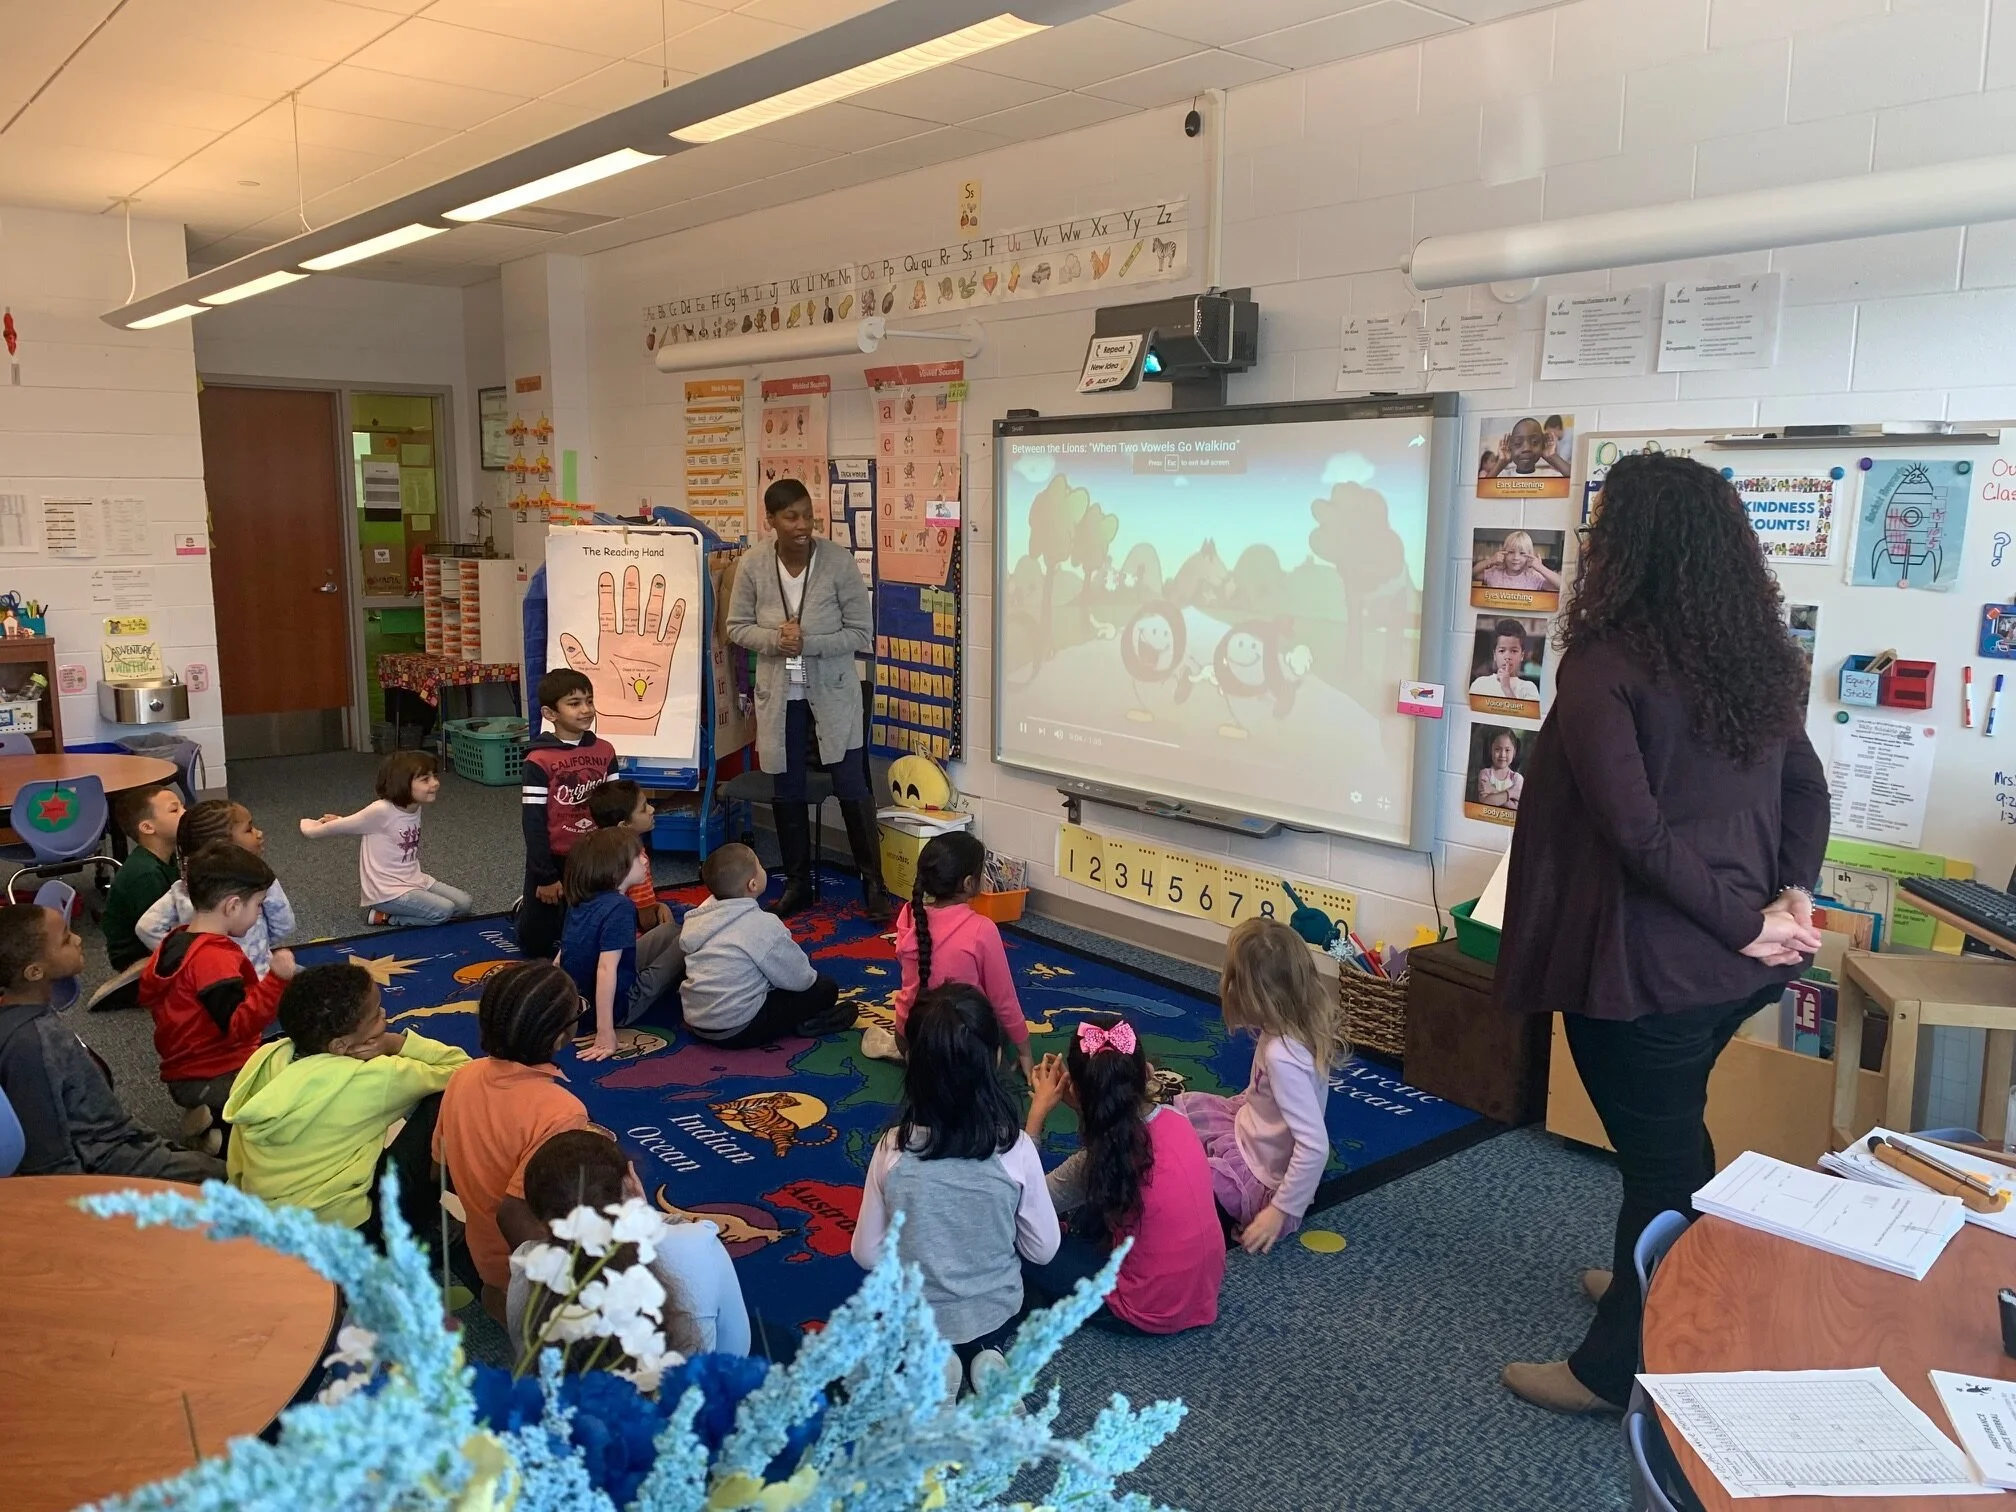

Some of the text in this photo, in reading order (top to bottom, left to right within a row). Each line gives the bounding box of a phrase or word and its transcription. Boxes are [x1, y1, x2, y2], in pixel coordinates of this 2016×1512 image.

[964, 183, 975, 199] Ss
[658, 305, 666, 318] Bb
[680, 300, 691, 314] Dd
[696, 298, 705, 312] Ee
[711, 294, 720, 309] Ff
[724, 292, 736, 312] Gg
[740, 288, 750, 304] Hh
[769, 282, 778, 304] Jj
[790, 279, 800, 295] Kk
[820, 272, 835, 289] Mm
[838, 269, 851, 286] Nn
[861, 264, 875, 281] Oo
[883, 260, 894, 283] Pp
[904, 255, 918, 272] Qu
[922, 259, 932, 276] qu
[940, 248, 950, 265] Rr
[962, 243, 972, 262] Ss
[982, 238, 995, 257] Tt
[1007, 234, 1021, 252] Uu
[1033, 228, 1048, 247] Vv
[1059, 222, 1081, 243] Ww
[1091, 217, 1108, 237] Xx
[1123, 210, 1141, 239] Yy
[1157, 205, 1172, 225] Zz
[1103, 345, 1126, 354] Repeat
[938, 367, 960, 376] Sounds
[1090, 361, 1119, 371] New Idea
[883, 405, 892, 419] a
[883, 438, 891, 452] e
[1012, 439, 1240, 454] Between the Lions: "When Two Vowels Go Walking"
[886, 468, 891, 484] i
[1910, 473, 1923, 482] 25
[1496, 480, 1545, 490] Ears Listening
[884, 503, 892, 516] o
[1743, 501, 1815, 514] KINDNESS
[1750, 518, 1810, 531] OUNTS!
[1928, 528, 1940, 536] 10
[884, 535, 892, 548] u
[1927, 538, 1938, 549] 5
[582, 546, 664, 559] The Reading Hand
[1485, 590, 1499, 600] Eyes
[1500, 591, 1533, 603] Watching
[714, 651, 725, 665] er
[718, 680, 726, 695] ir
[1845, 675, 1876, 688] Equity
[1843, 689, 1873, 699] Sticks
[1486, 699, 1524, 710] Voice Quiet
[718, 712, 729, 726] ur
[1483, 807, 1514, 818] Body Still
[1838, 871, 1851, 882] sh
[1070, 849, 1275, 919] 1 2 3 4 5 6 7 8
[1340, 1062, 1444, 1104] Arctic
[1328, 1076, 1414, 1116] Ocean
[667, 1113, 756, 1165] Indian
[627, 1126, 701, 1173] Ocean
